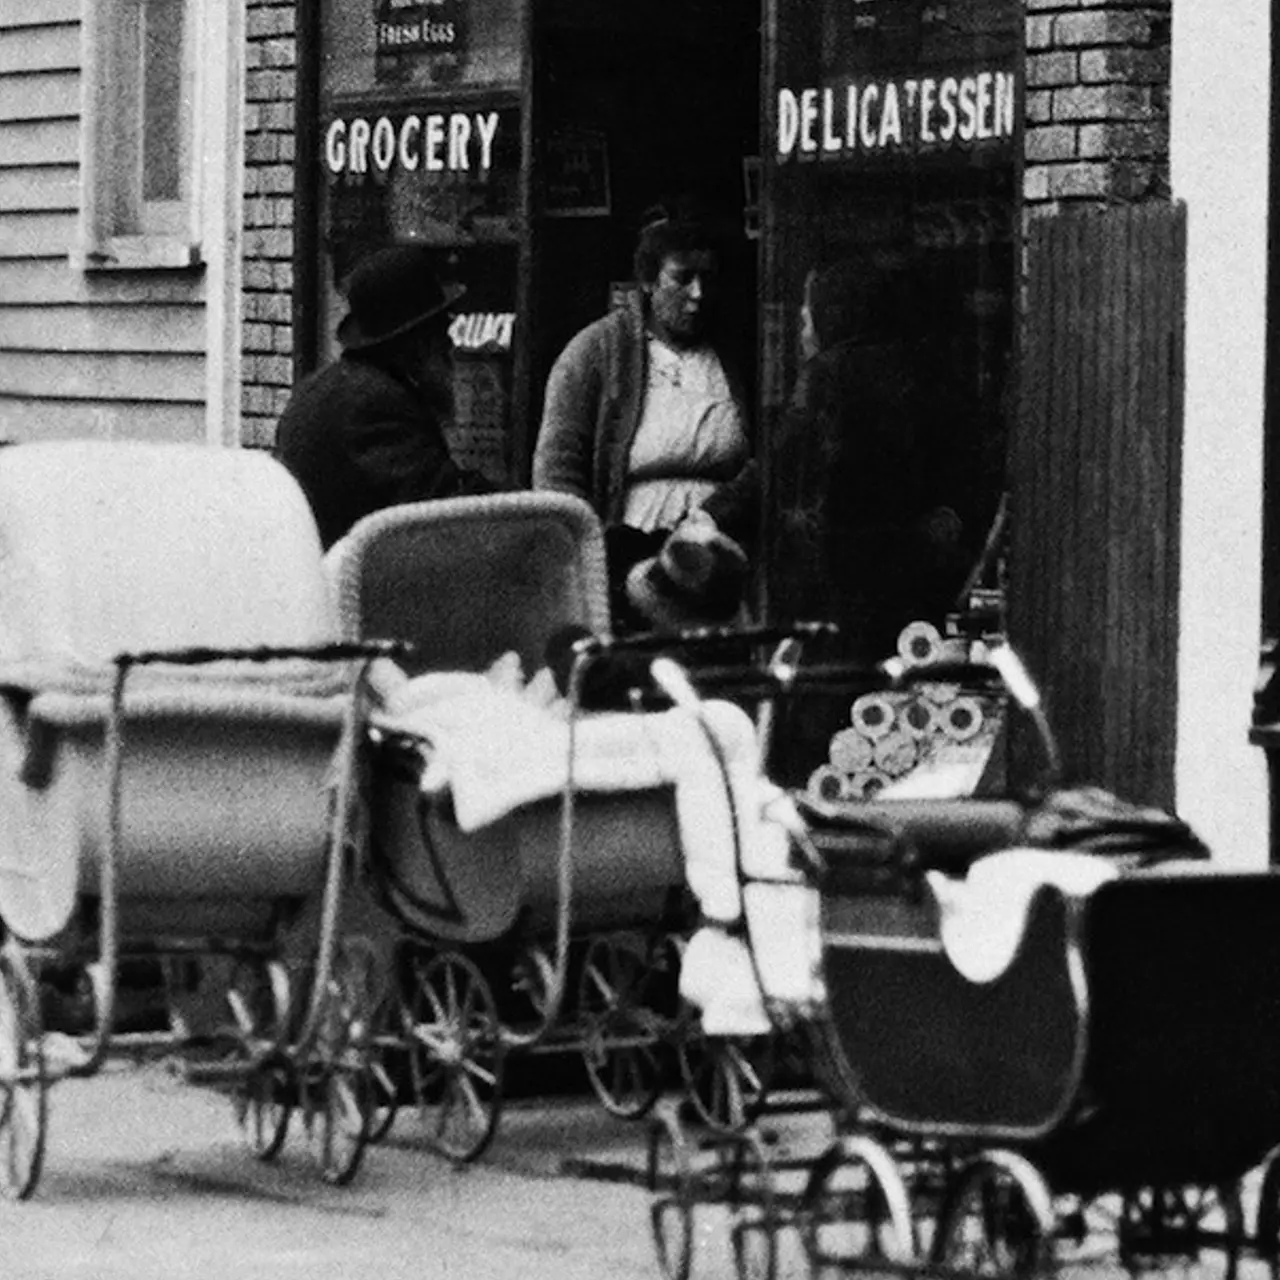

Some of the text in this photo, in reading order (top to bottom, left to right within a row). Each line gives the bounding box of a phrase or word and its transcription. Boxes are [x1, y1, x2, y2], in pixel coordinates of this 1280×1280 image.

[422, 19, 456, 44] EGGS
[325, 111, 499, 173] GROCERY
[777, 71, 1015, 155] DELICATESSEN
